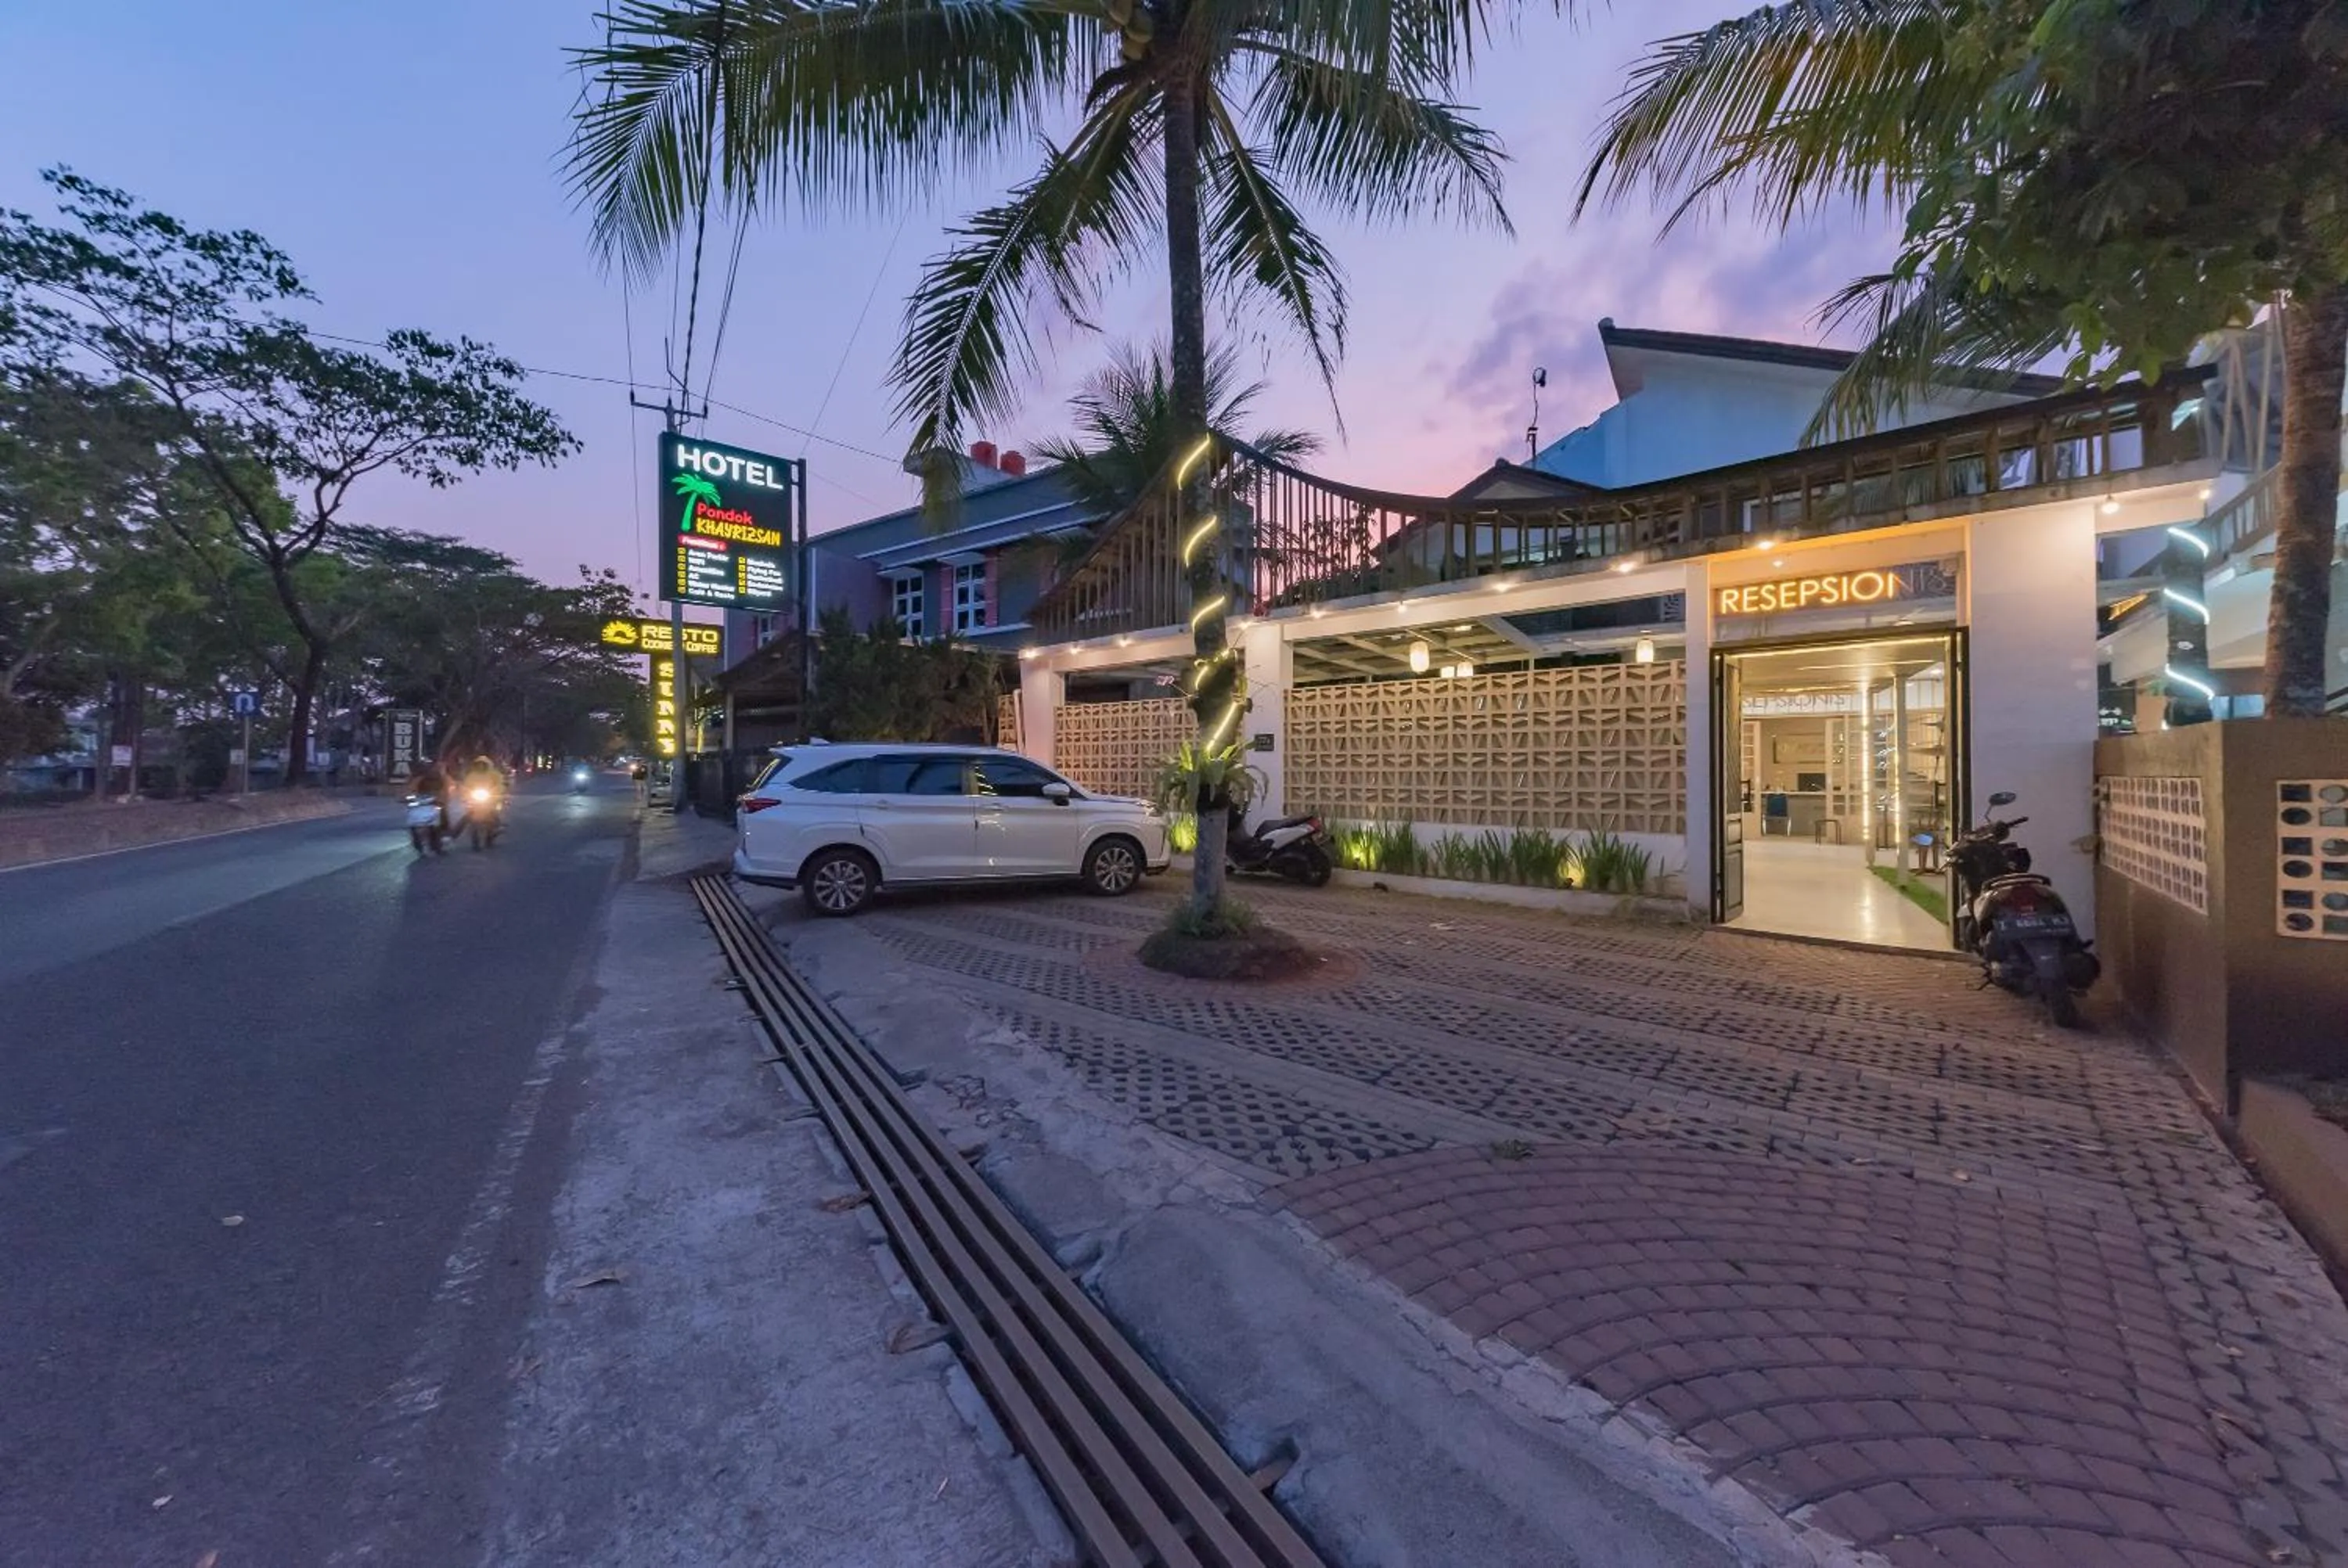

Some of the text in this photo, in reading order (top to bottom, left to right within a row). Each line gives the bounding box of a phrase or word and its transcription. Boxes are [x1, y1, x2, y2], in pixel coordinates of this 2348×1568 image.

[677, 444, 783, 490] HOTEL
[697, 503, 752, 525] Pondok
[394, 721, 412, 775] BUKA
